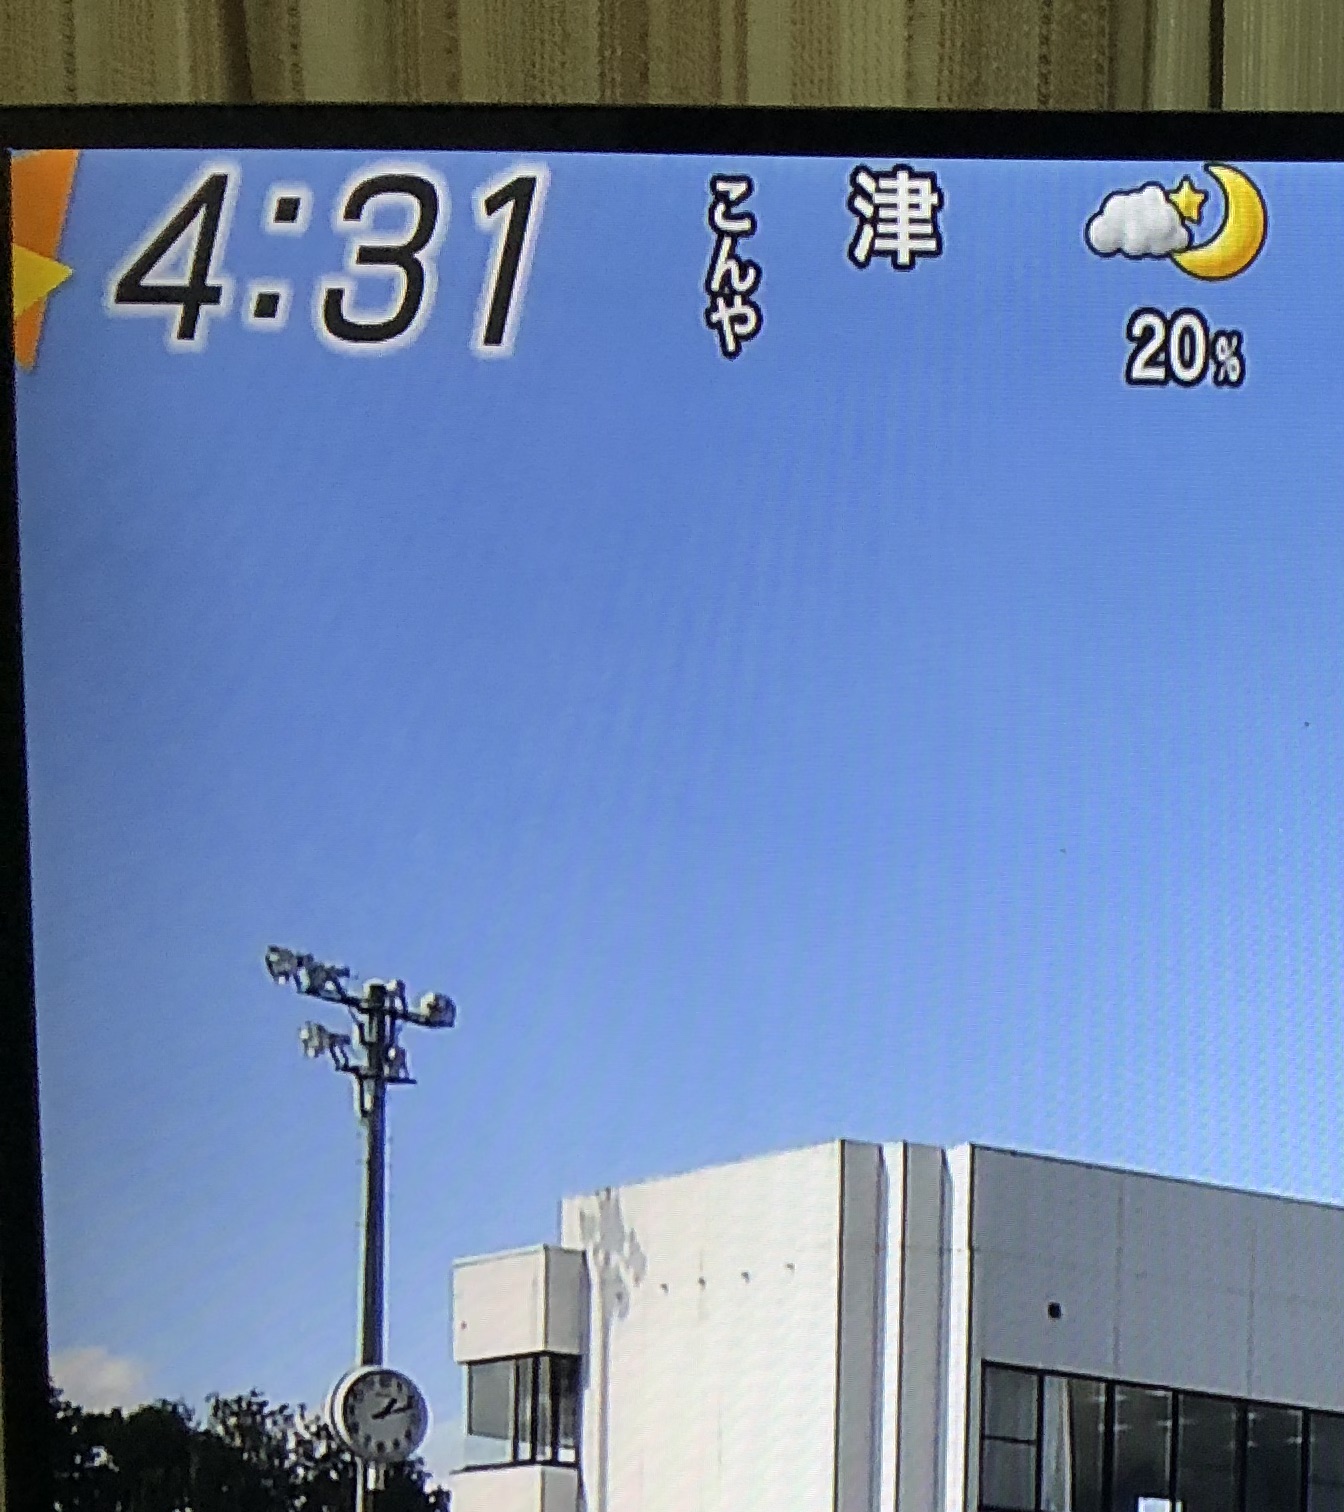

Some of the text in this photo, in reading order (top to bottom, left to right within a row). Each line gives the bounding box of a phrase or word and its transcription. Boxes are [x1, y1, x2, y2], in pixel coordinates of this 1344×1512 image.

[110, 165, 547, 353] 4:31
[705, 173, 762, 356] こんや
[849, 165, 943, 268] 津
[1126, 307, 1245, 386] 20%
